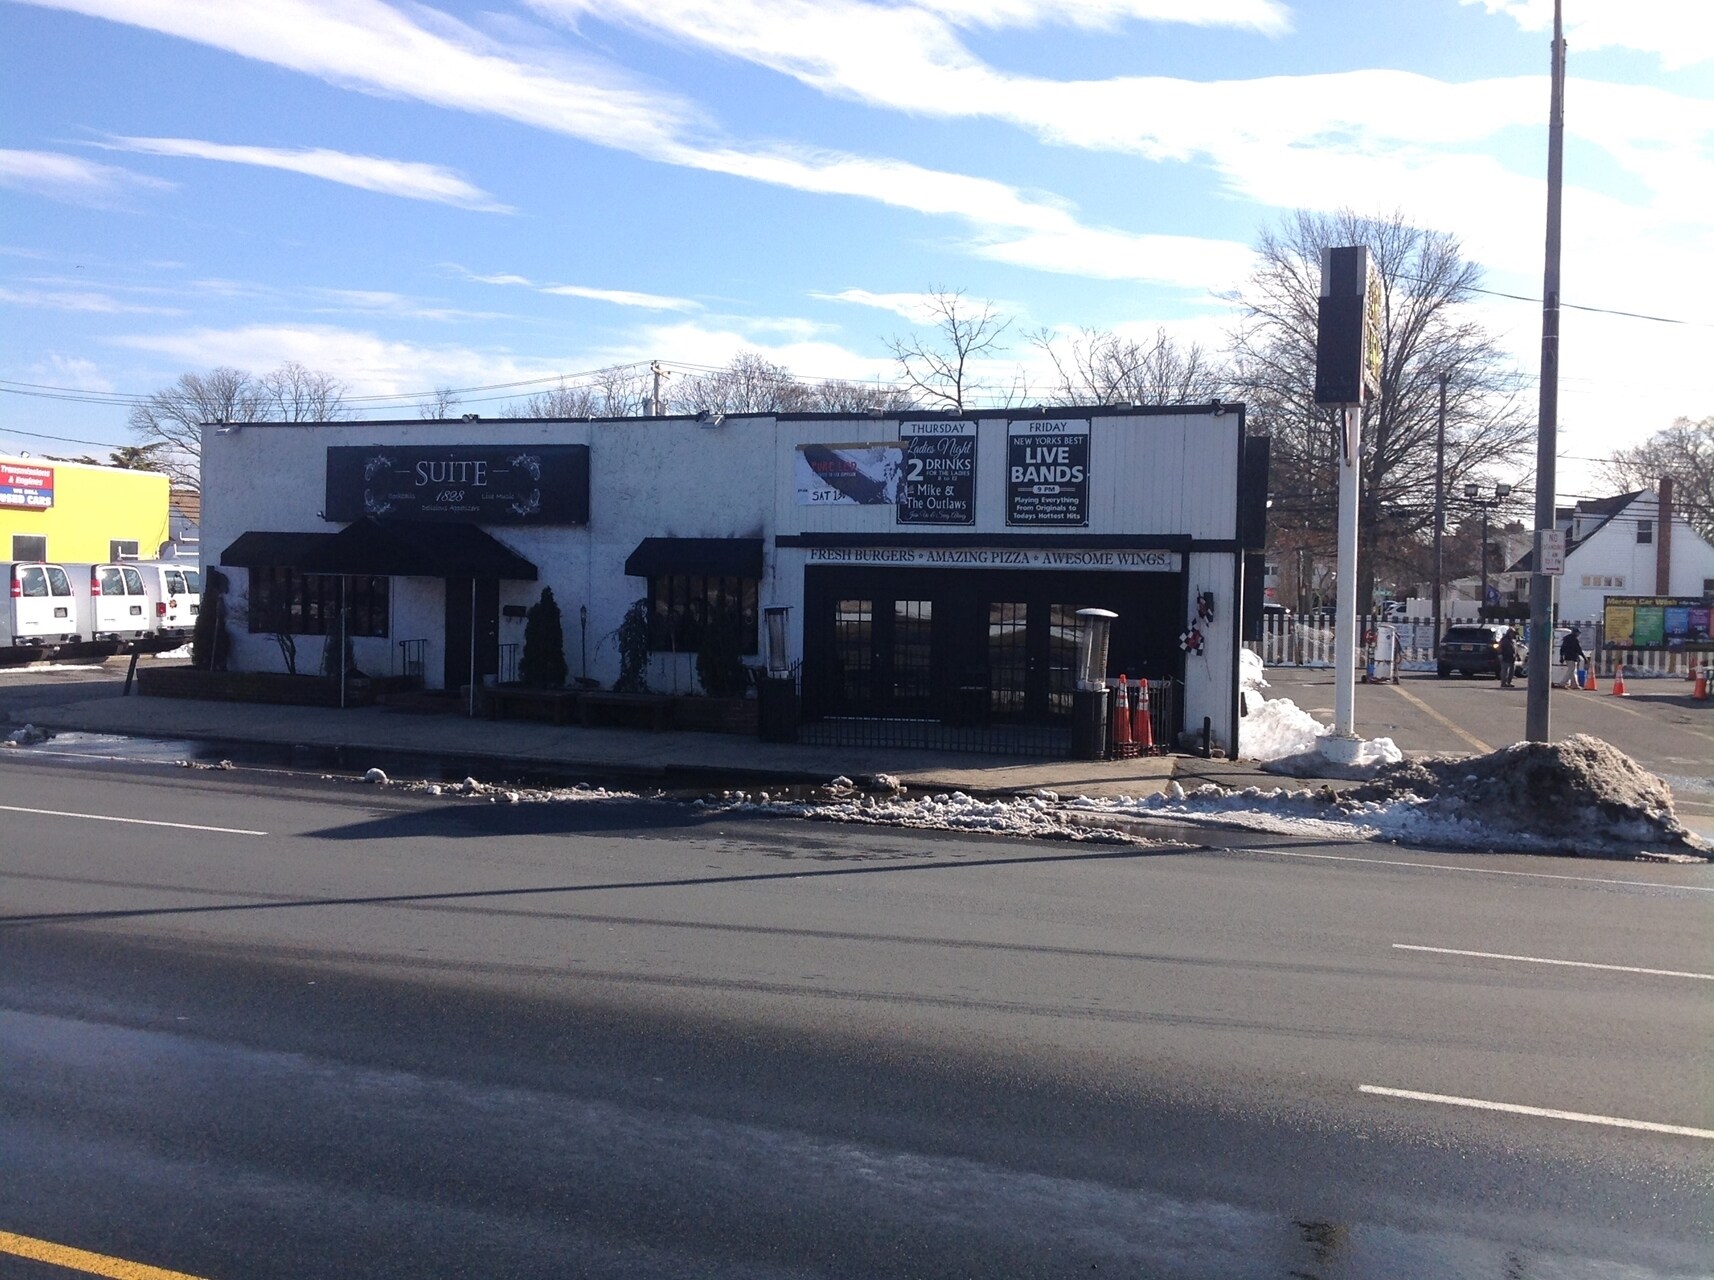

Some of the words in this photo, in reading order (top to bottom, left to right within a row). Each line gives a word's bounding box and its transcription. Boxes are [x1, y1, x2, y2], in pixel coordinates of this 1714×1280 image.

[911, 424, 966, 434] THURSDAY
[1029, 422, 1067, 432] FRIDAY
[1014, 437, 1032, 446] NEW
[1035, 437, 1061, 445] YORKS
[1064, 436, 1083, 445] BEST
[908, 437, 935, 458] Ladies
[937, 437, 972, 460] Night
[1025, 447, 1069, 464] LIVE
[415, 460, 488, 486] SUITE
[907, 458, 924, 481] 2
[926, 458, 971, 470] DRINKS
[1011, 465, 1084, 483] BANDS
[15, 476, 44, 486] Engines
[436, 490, 465, 502] 1828
[812, 491, 831, 501] SAT
[917, 484, 942, 496] Mike
[945, 485, 955, 496] &
[27, 495, 52, 506] CARS
[907, 497, 924, 509] The
[926, 497, 967, 509] Outlaws
[1014, 496, 1039, 504] Playing
[1041, 496, 1079, 504] Everything
[1035, 504, 1066, 512] Originals
[810, 549, 851, 561] FRESH
[854, 549, 915, 562] BURGERS
[926, 551, 988, 563] AMAZING
[990, 551, 1030, 564] PIZZA
[1042, 552, 1114, 565] AWESOME
[1117, 552, 1165, 566] WINGS
